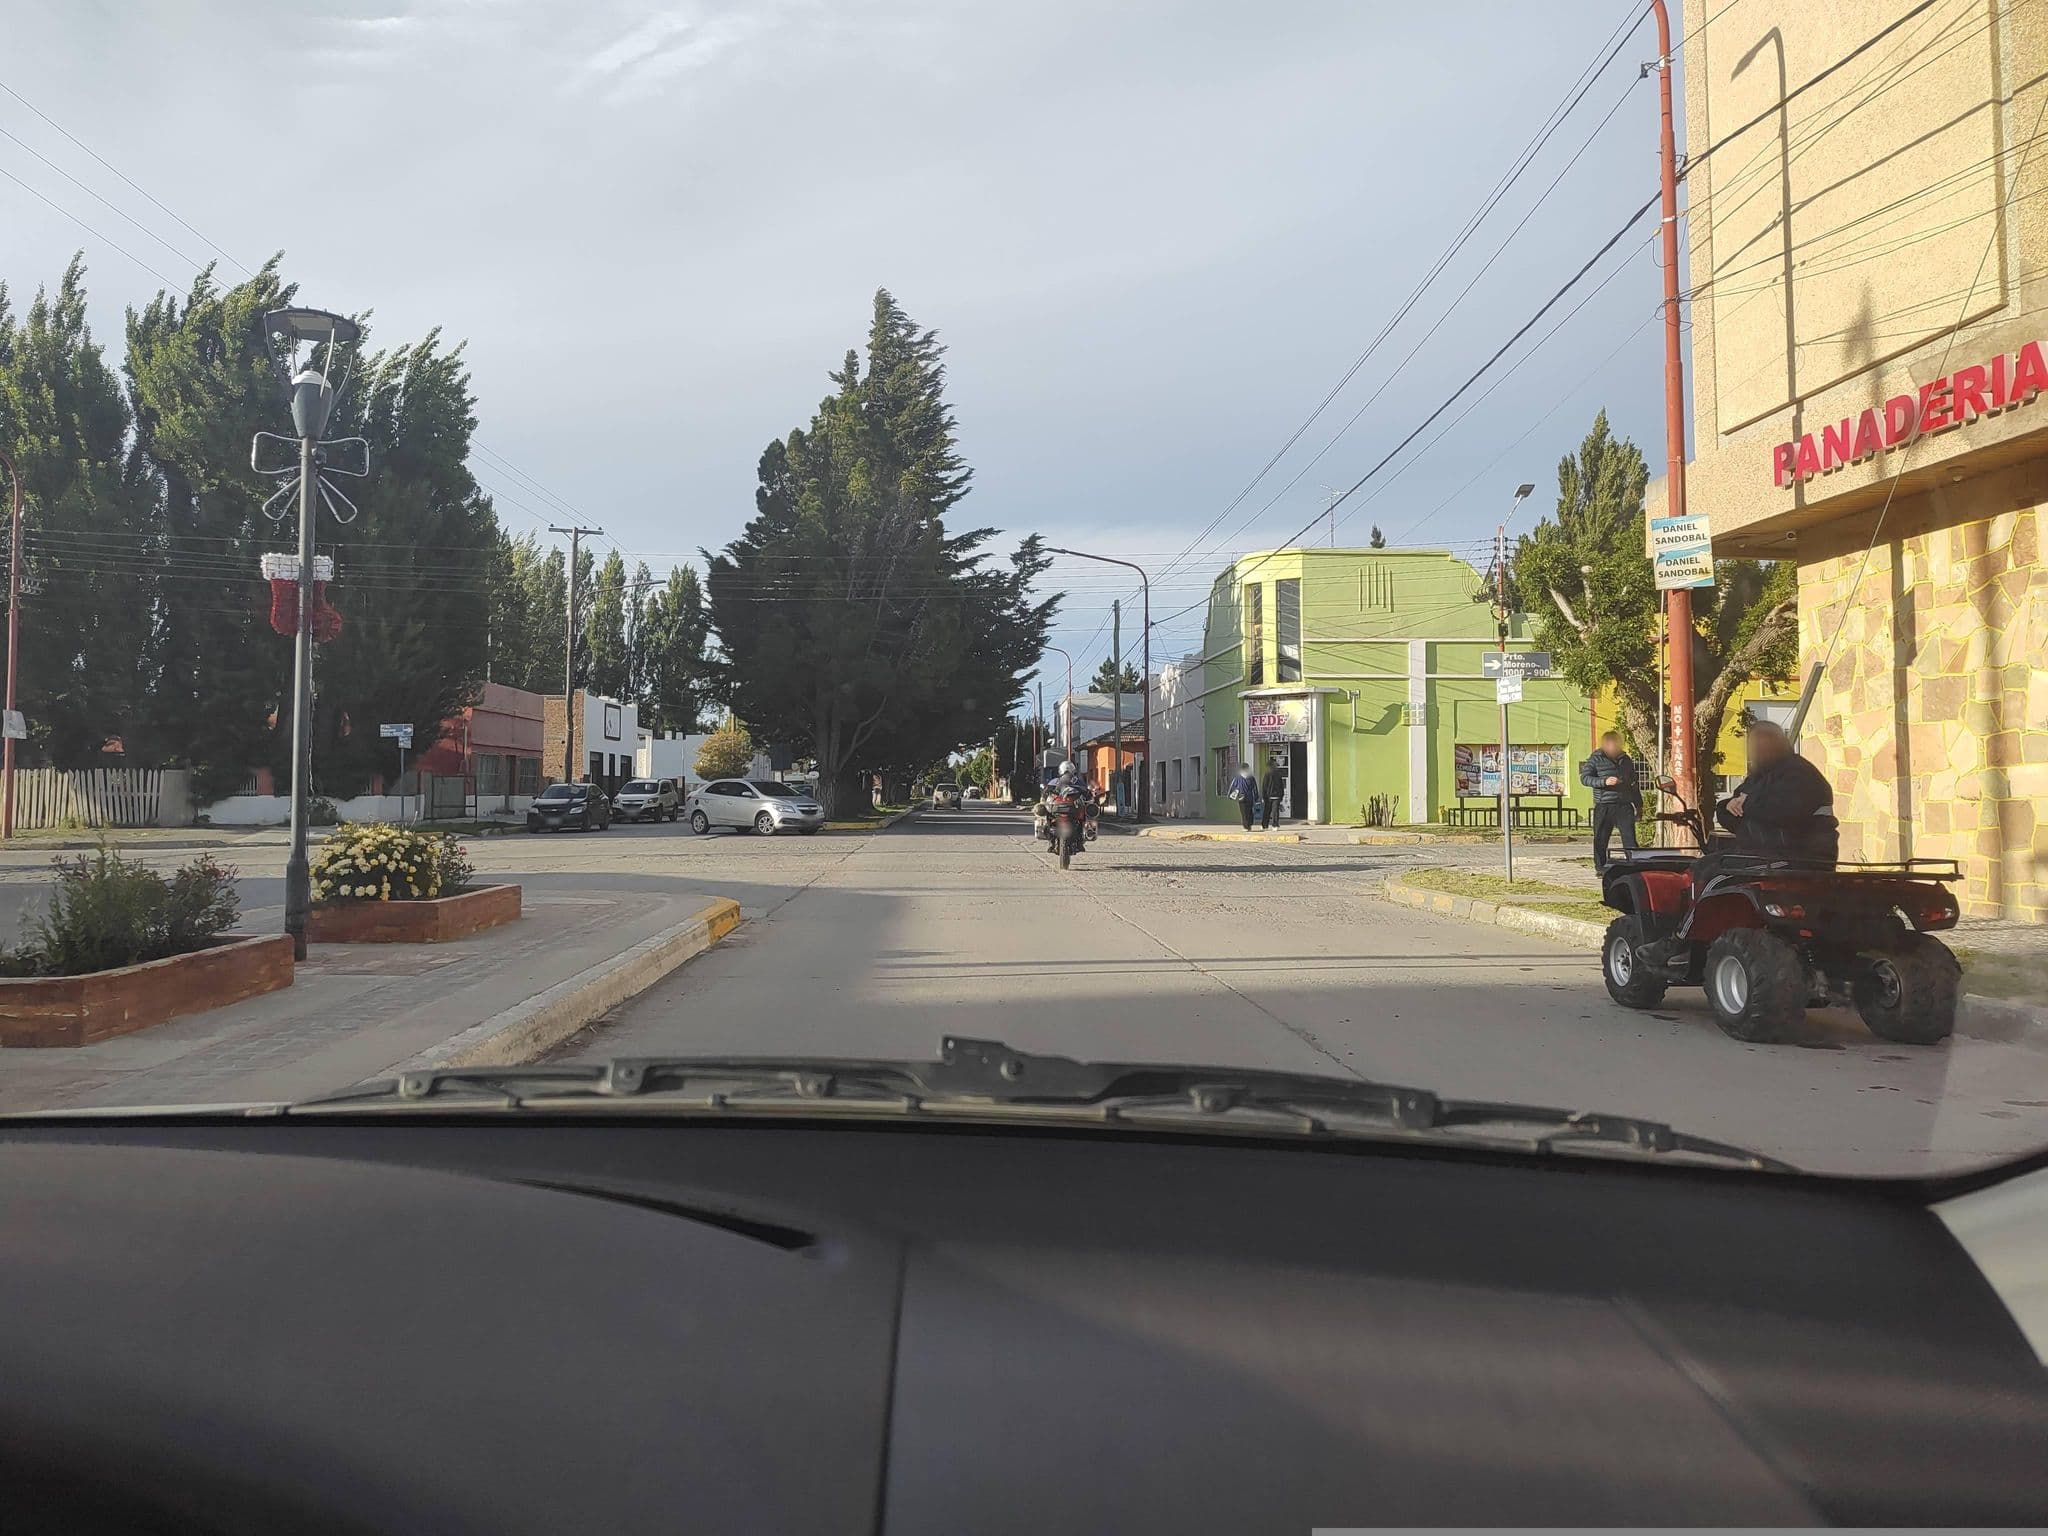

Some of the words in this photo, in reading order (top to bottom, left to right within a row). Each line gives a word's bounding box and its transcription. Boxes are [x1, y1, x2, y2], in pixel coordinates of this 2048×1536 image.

[1773, 340, 2048, 488] PANADERIA
[1662, 523, 1698, 533] DANIEL
[1655, 533, 1708, 545] SANDOBAL
[1665, 556, 1701, 567] DANIEL
[1658, 567, 1711, 578] SANDOBAL
[1503, 653, 1526, 661] Prto.
[1503, 668, 1525, 677] 1000
[1533, 668, 1550, 677] 900
[1251, 714, 1286, 727] FEDE
